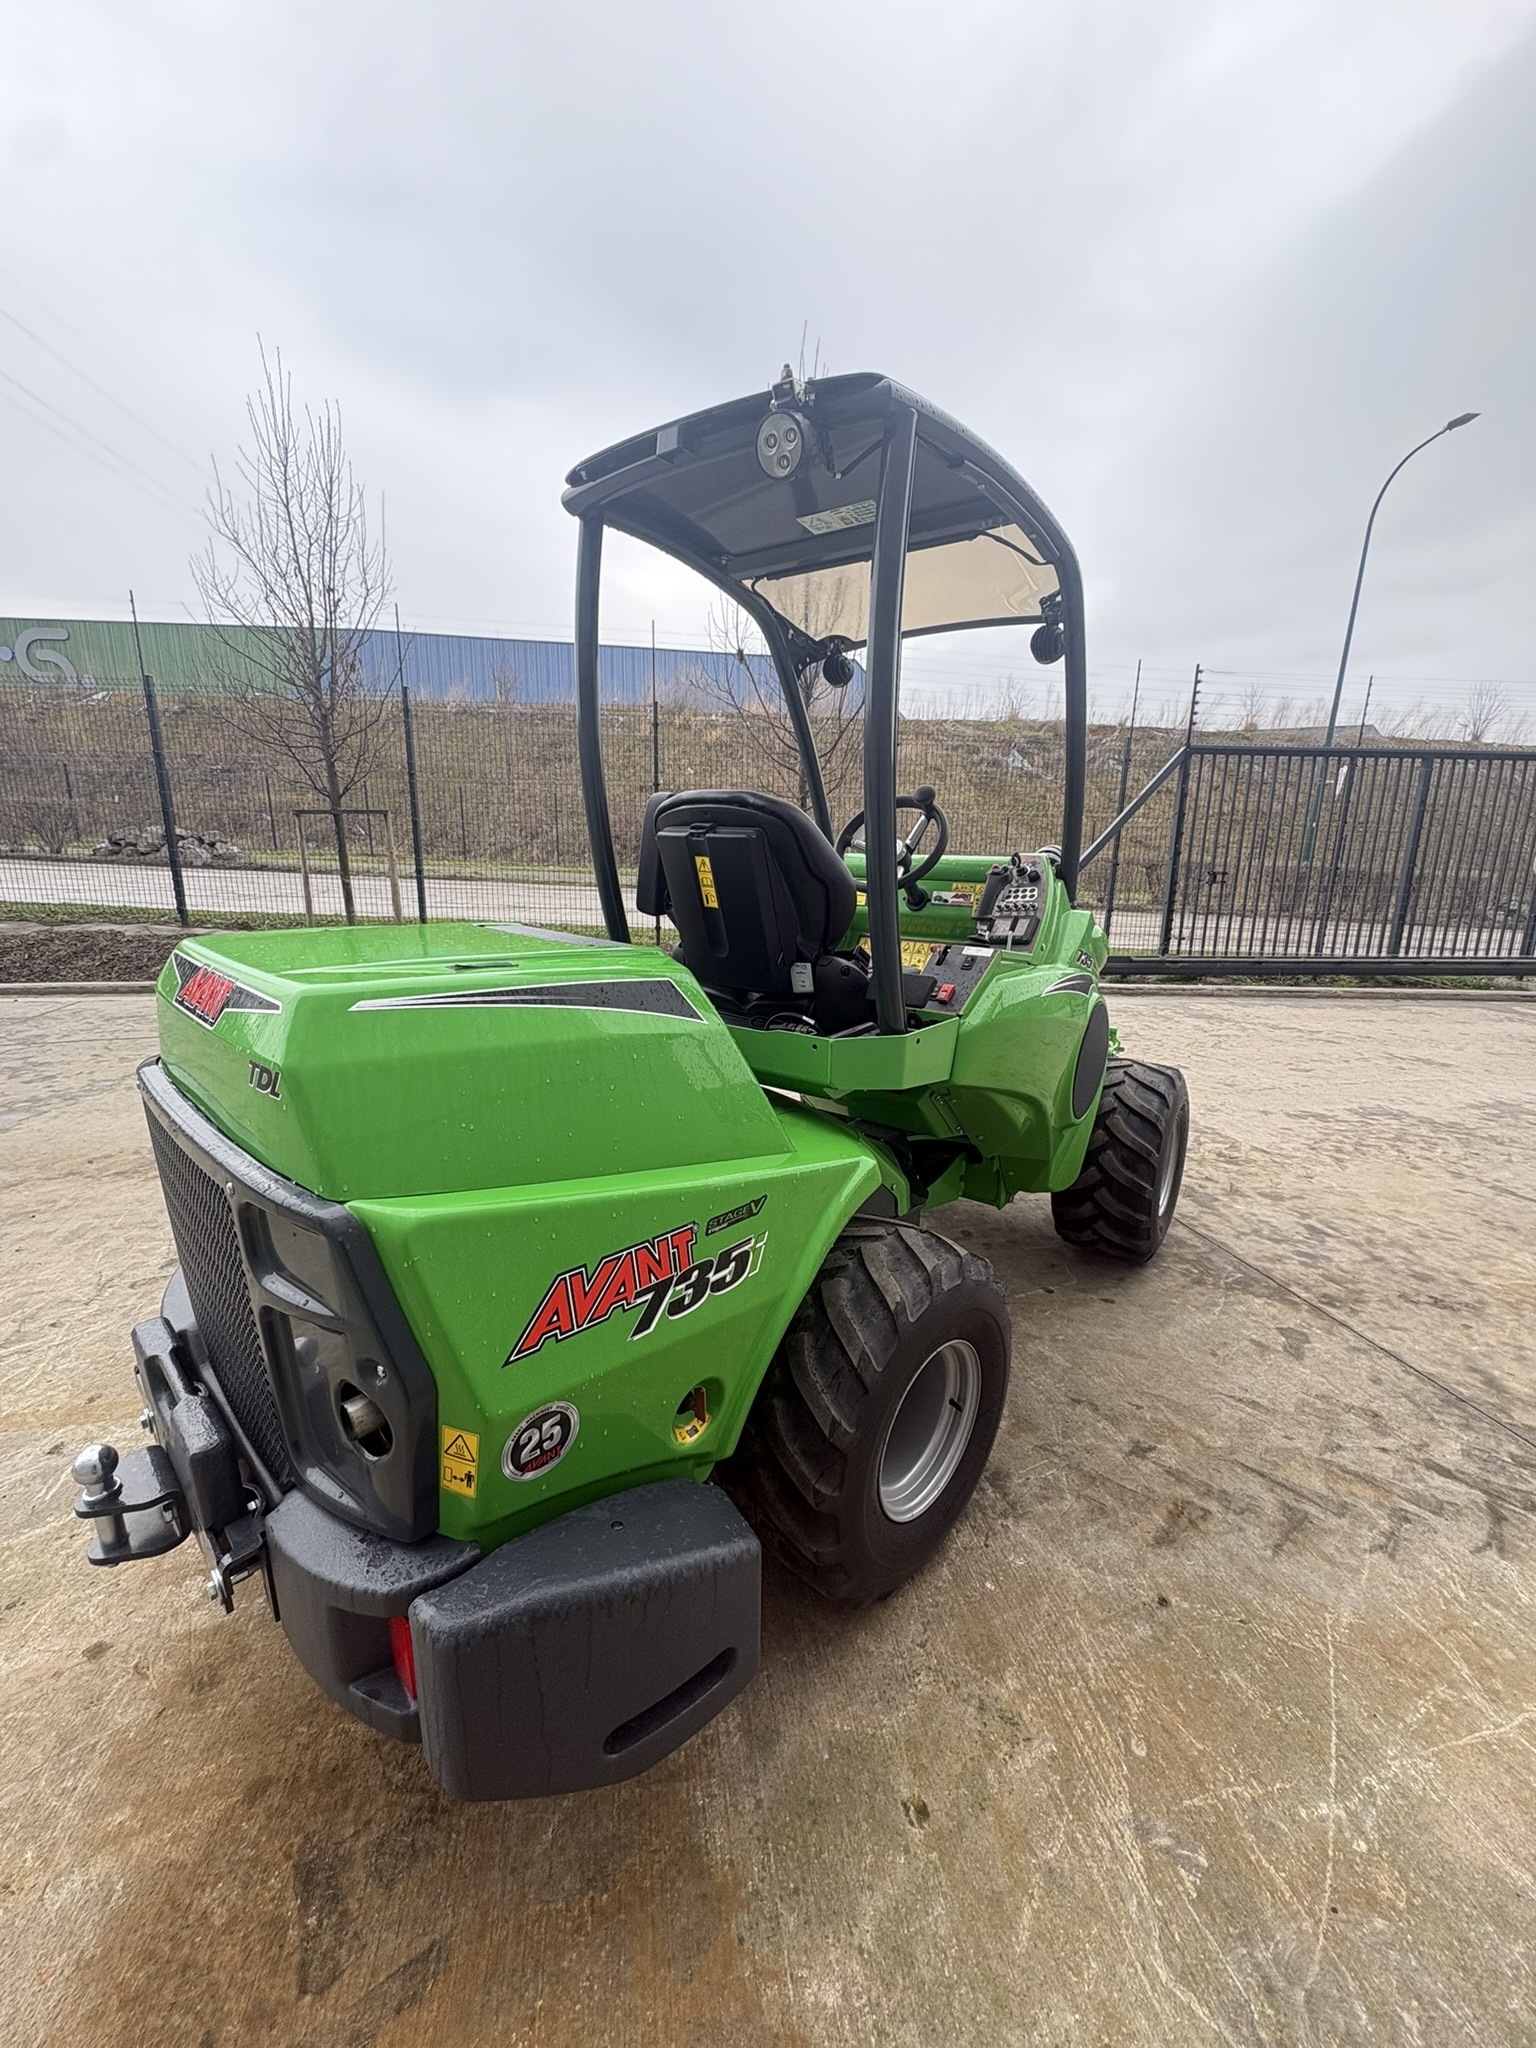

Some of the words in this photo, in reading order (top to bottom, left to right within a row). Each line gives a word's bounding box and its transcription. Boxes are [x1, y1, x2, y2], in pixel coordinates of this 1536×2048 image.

[1077, 949, 1095, 969] 735
[177, 964, 238, 1022] AVANT
[249, 1060, 281, 1100] TDL
[708, 1205, 751, 1228] STAGE
[750, 1197, 766, 1215] V
[502, 1222, 696, 1367] AVANT
[628, 1231, 769, 1342] 735i
[519, 1412, 562, 1466] 25
[519, 1444, 562, 1478] AVANT
